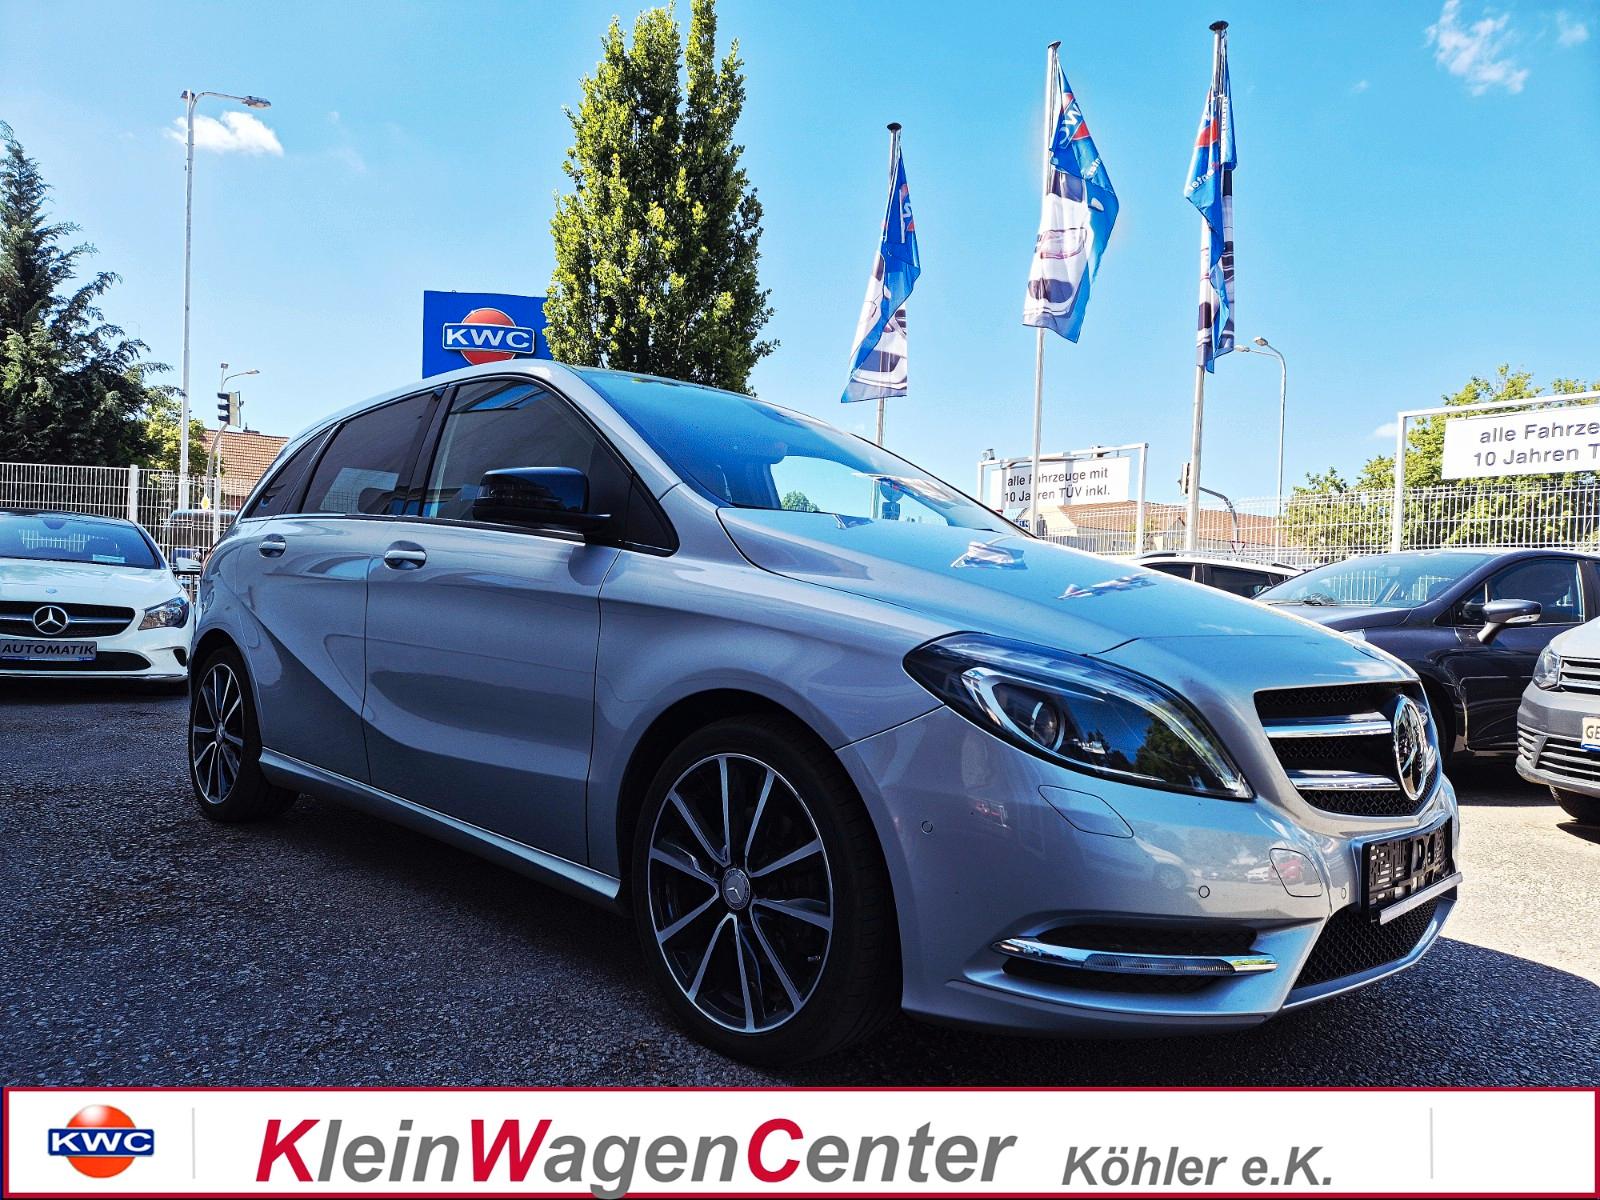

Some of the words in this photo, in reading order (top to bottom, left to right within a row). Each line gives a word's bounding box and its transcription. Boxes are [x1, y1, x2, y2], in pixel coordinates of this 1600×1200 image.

[446, 328, 530, 348] KWC
[1480, 426, 1517, 444] alle
[1524, 421, 1600, 440] Fahrze
[1473, 451, 1497, 467] 10
[1503, 447, 1579, 465] Jahren
[1007, 475, 1026, 487] alle
[1028, 472, 1086, 486] hrzeuge
[1089, 467, 1108, 480] mit
[1004, 491, 1016, 503] 10
[1018, 490, 1055, 502] Jaren
[1059, 484, 1082, 498] TÜV
[1085, 484, 1111, 497] inkl.
[2, 644, 95, 655] AUTOMATIK
